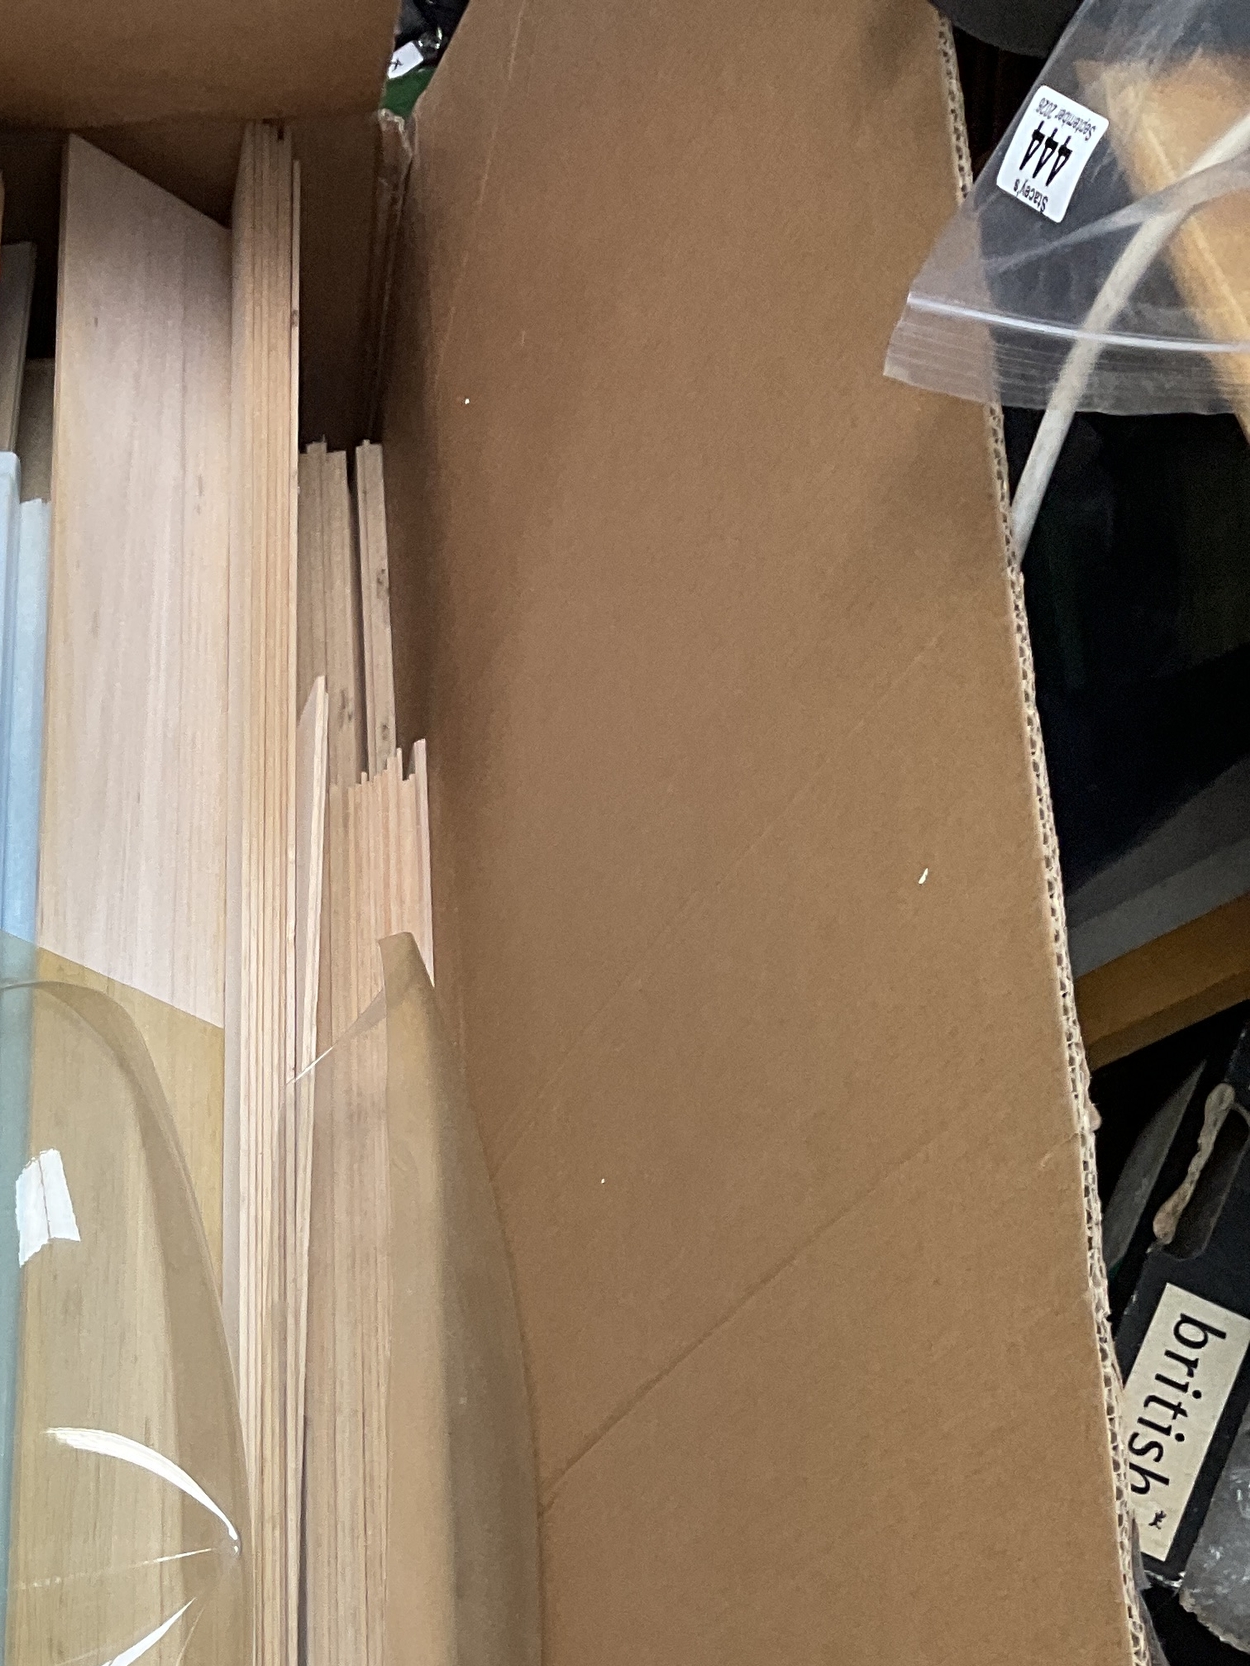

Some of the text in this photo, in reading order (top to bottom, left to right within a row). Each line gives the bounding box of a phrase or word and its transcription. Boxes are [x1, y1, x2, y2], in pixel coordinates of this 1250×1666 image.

[1053, 107, 1097, 142] September
[1018, 119, 1074, 187] 444
[1013, 178, 1049, 213] Stacey's
[1128, 1312, 1227, 1496] british
